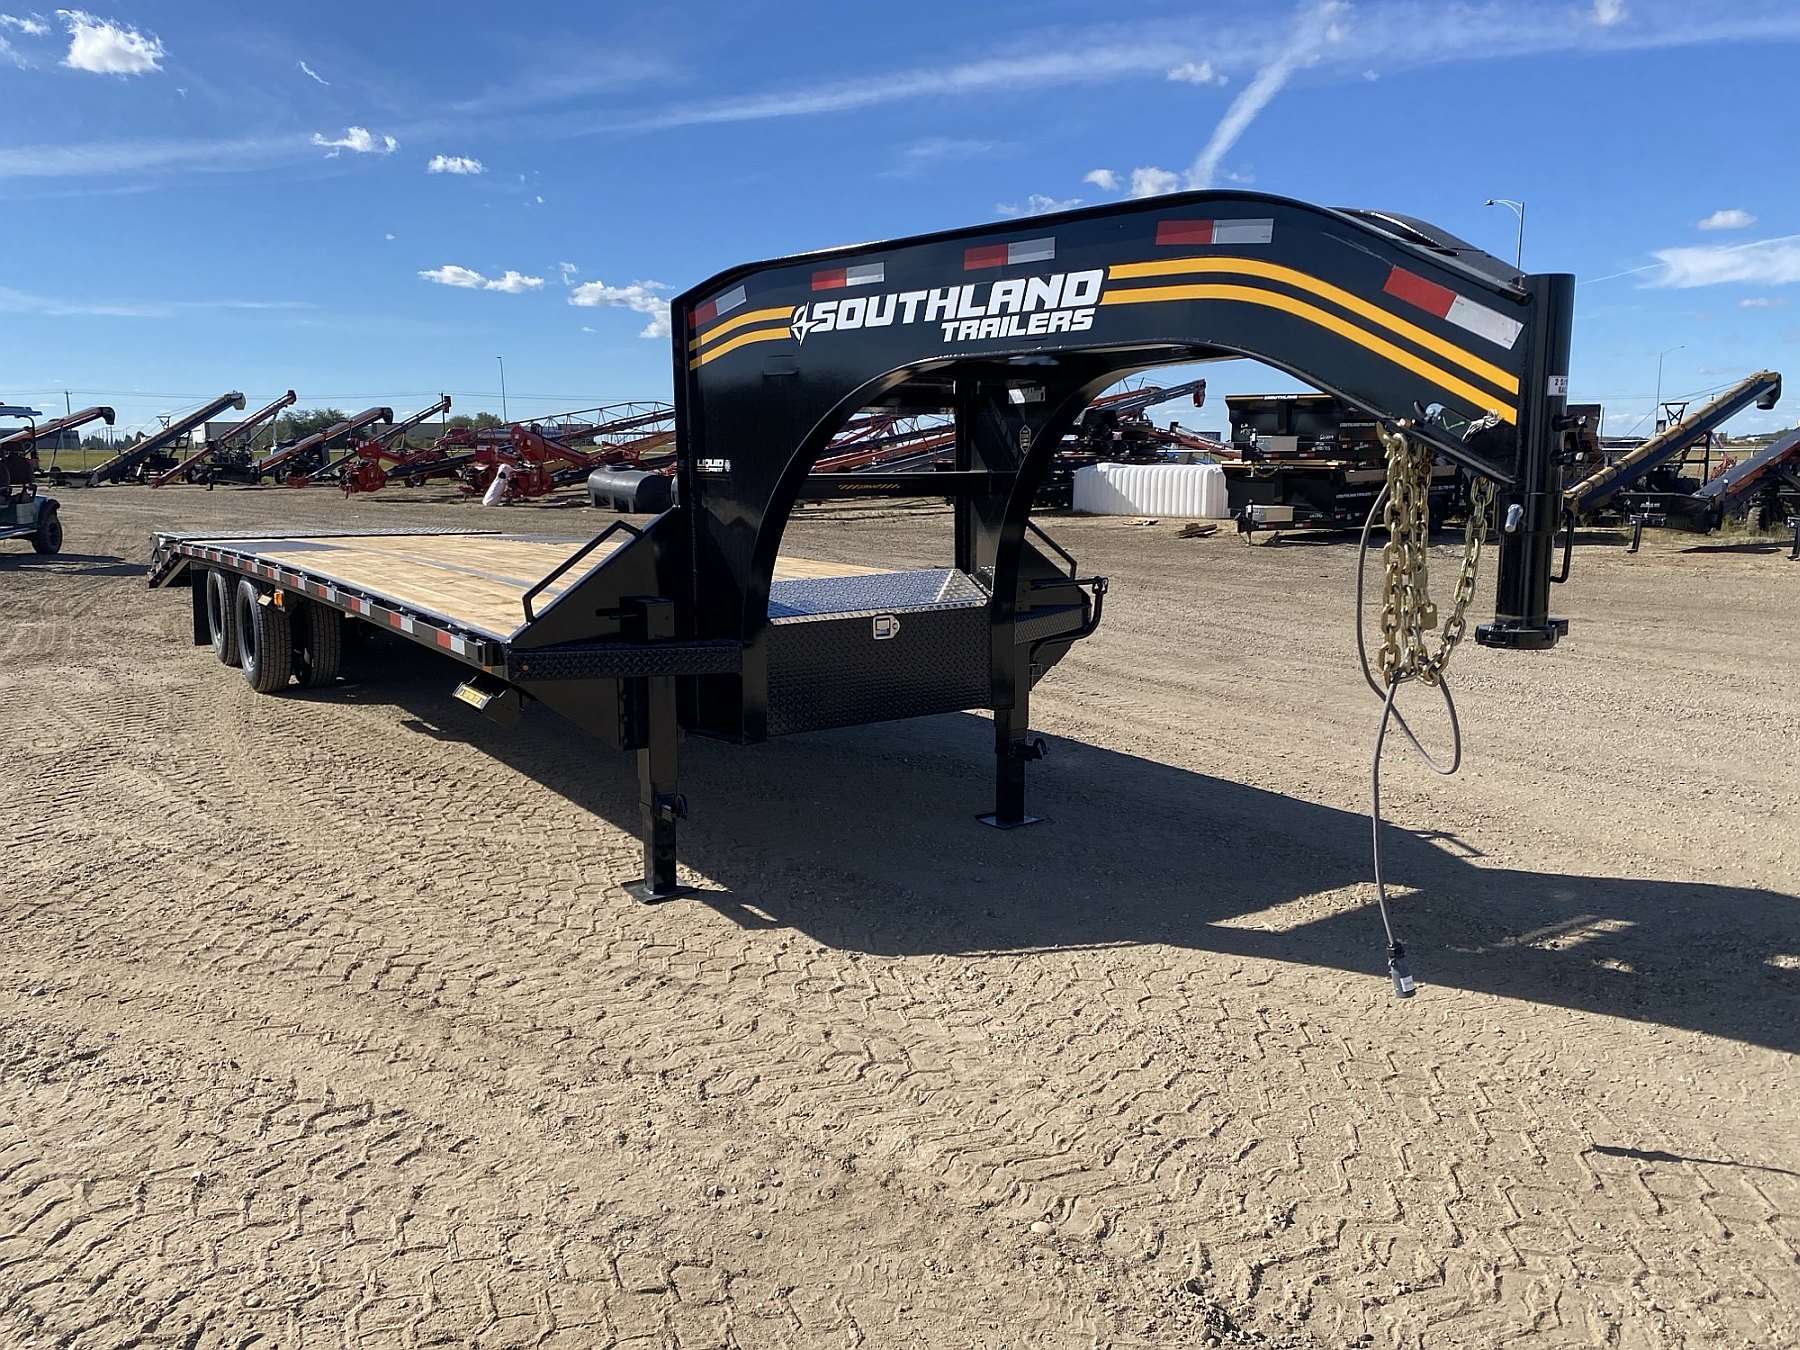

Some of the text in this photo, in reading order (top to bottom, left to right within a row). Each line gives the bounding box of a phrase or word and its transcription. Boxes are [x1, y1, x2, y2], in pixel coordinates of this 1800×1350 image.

[810, 269, 1104, 333] SOUTHLAND
[941, 308, 1096, 342] TRAILERS
[696, 458, 724, 468] LIQUID
